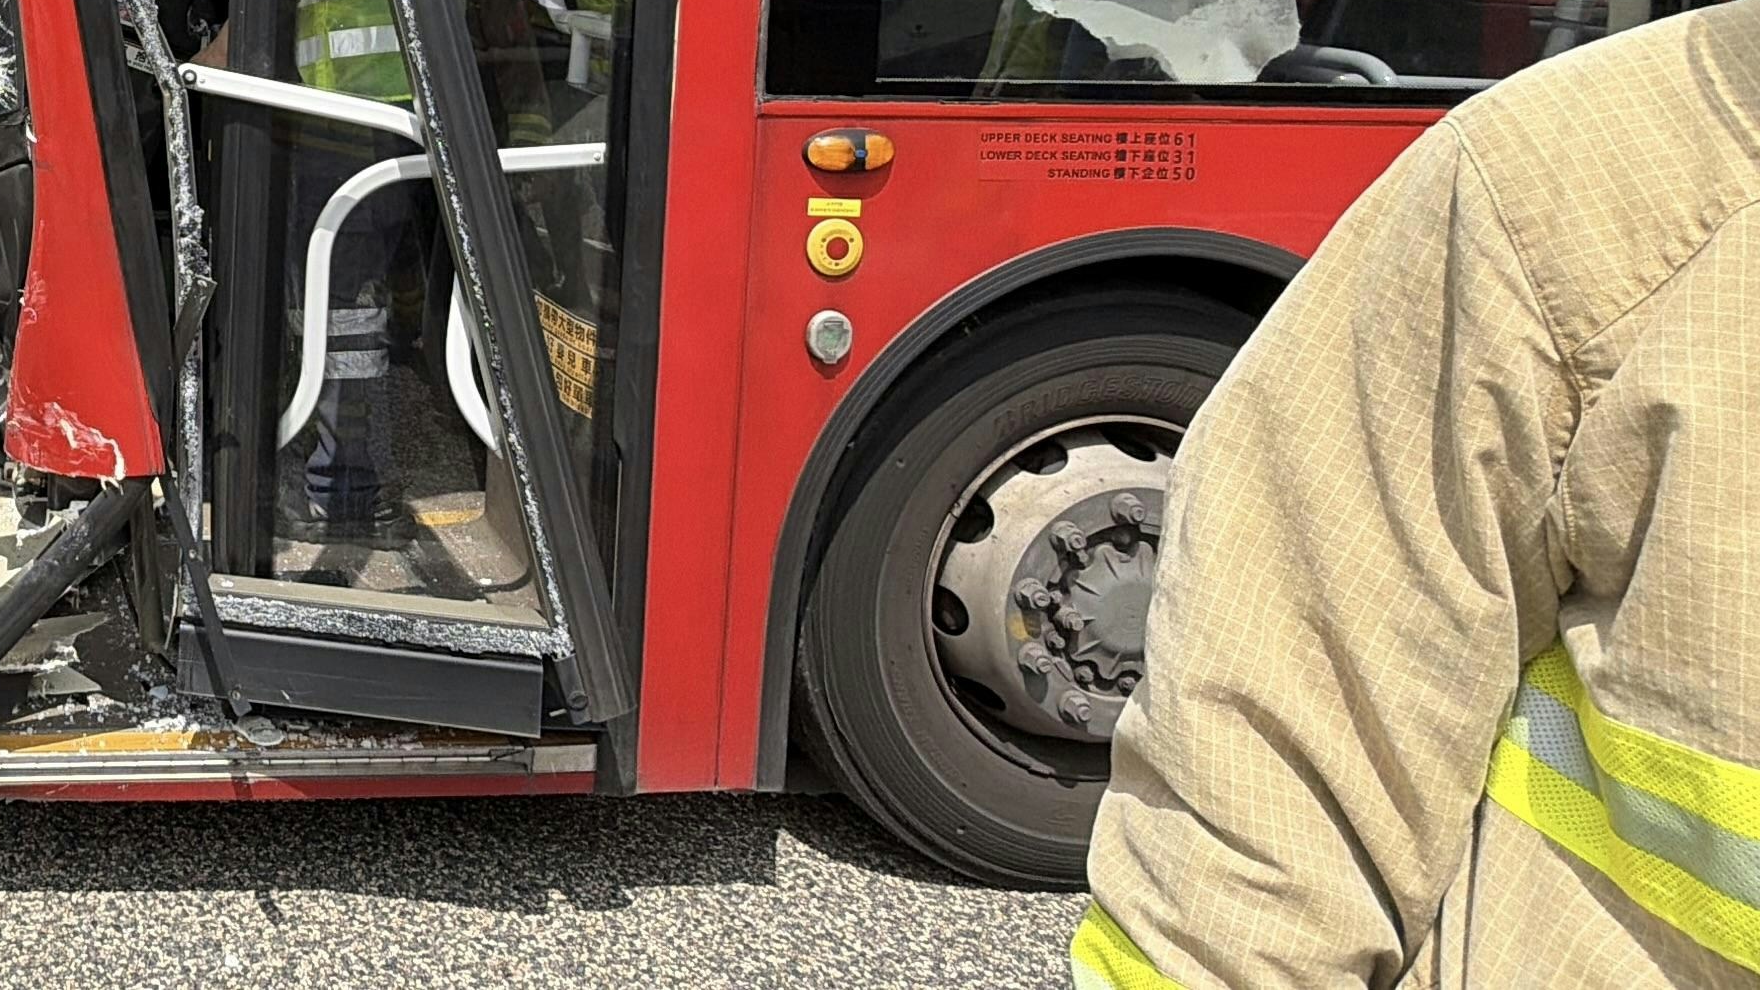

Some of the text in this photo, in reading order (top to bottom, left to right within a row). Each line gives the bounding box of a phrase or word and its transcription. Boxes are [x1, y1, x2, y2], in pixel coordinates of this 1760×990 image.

[980, 133, 1021, 144] UPPER
[1024, 133, 1057, 144] DECK
[1061, 133, 1112, 144] SEATING
[980, 150, 1022, 161] LOWER
[1025, 150, 1057, 161] DECK
[1061, 150, 1111, 161] SEATING
[1047, 168, 1111, 179] STANDING
